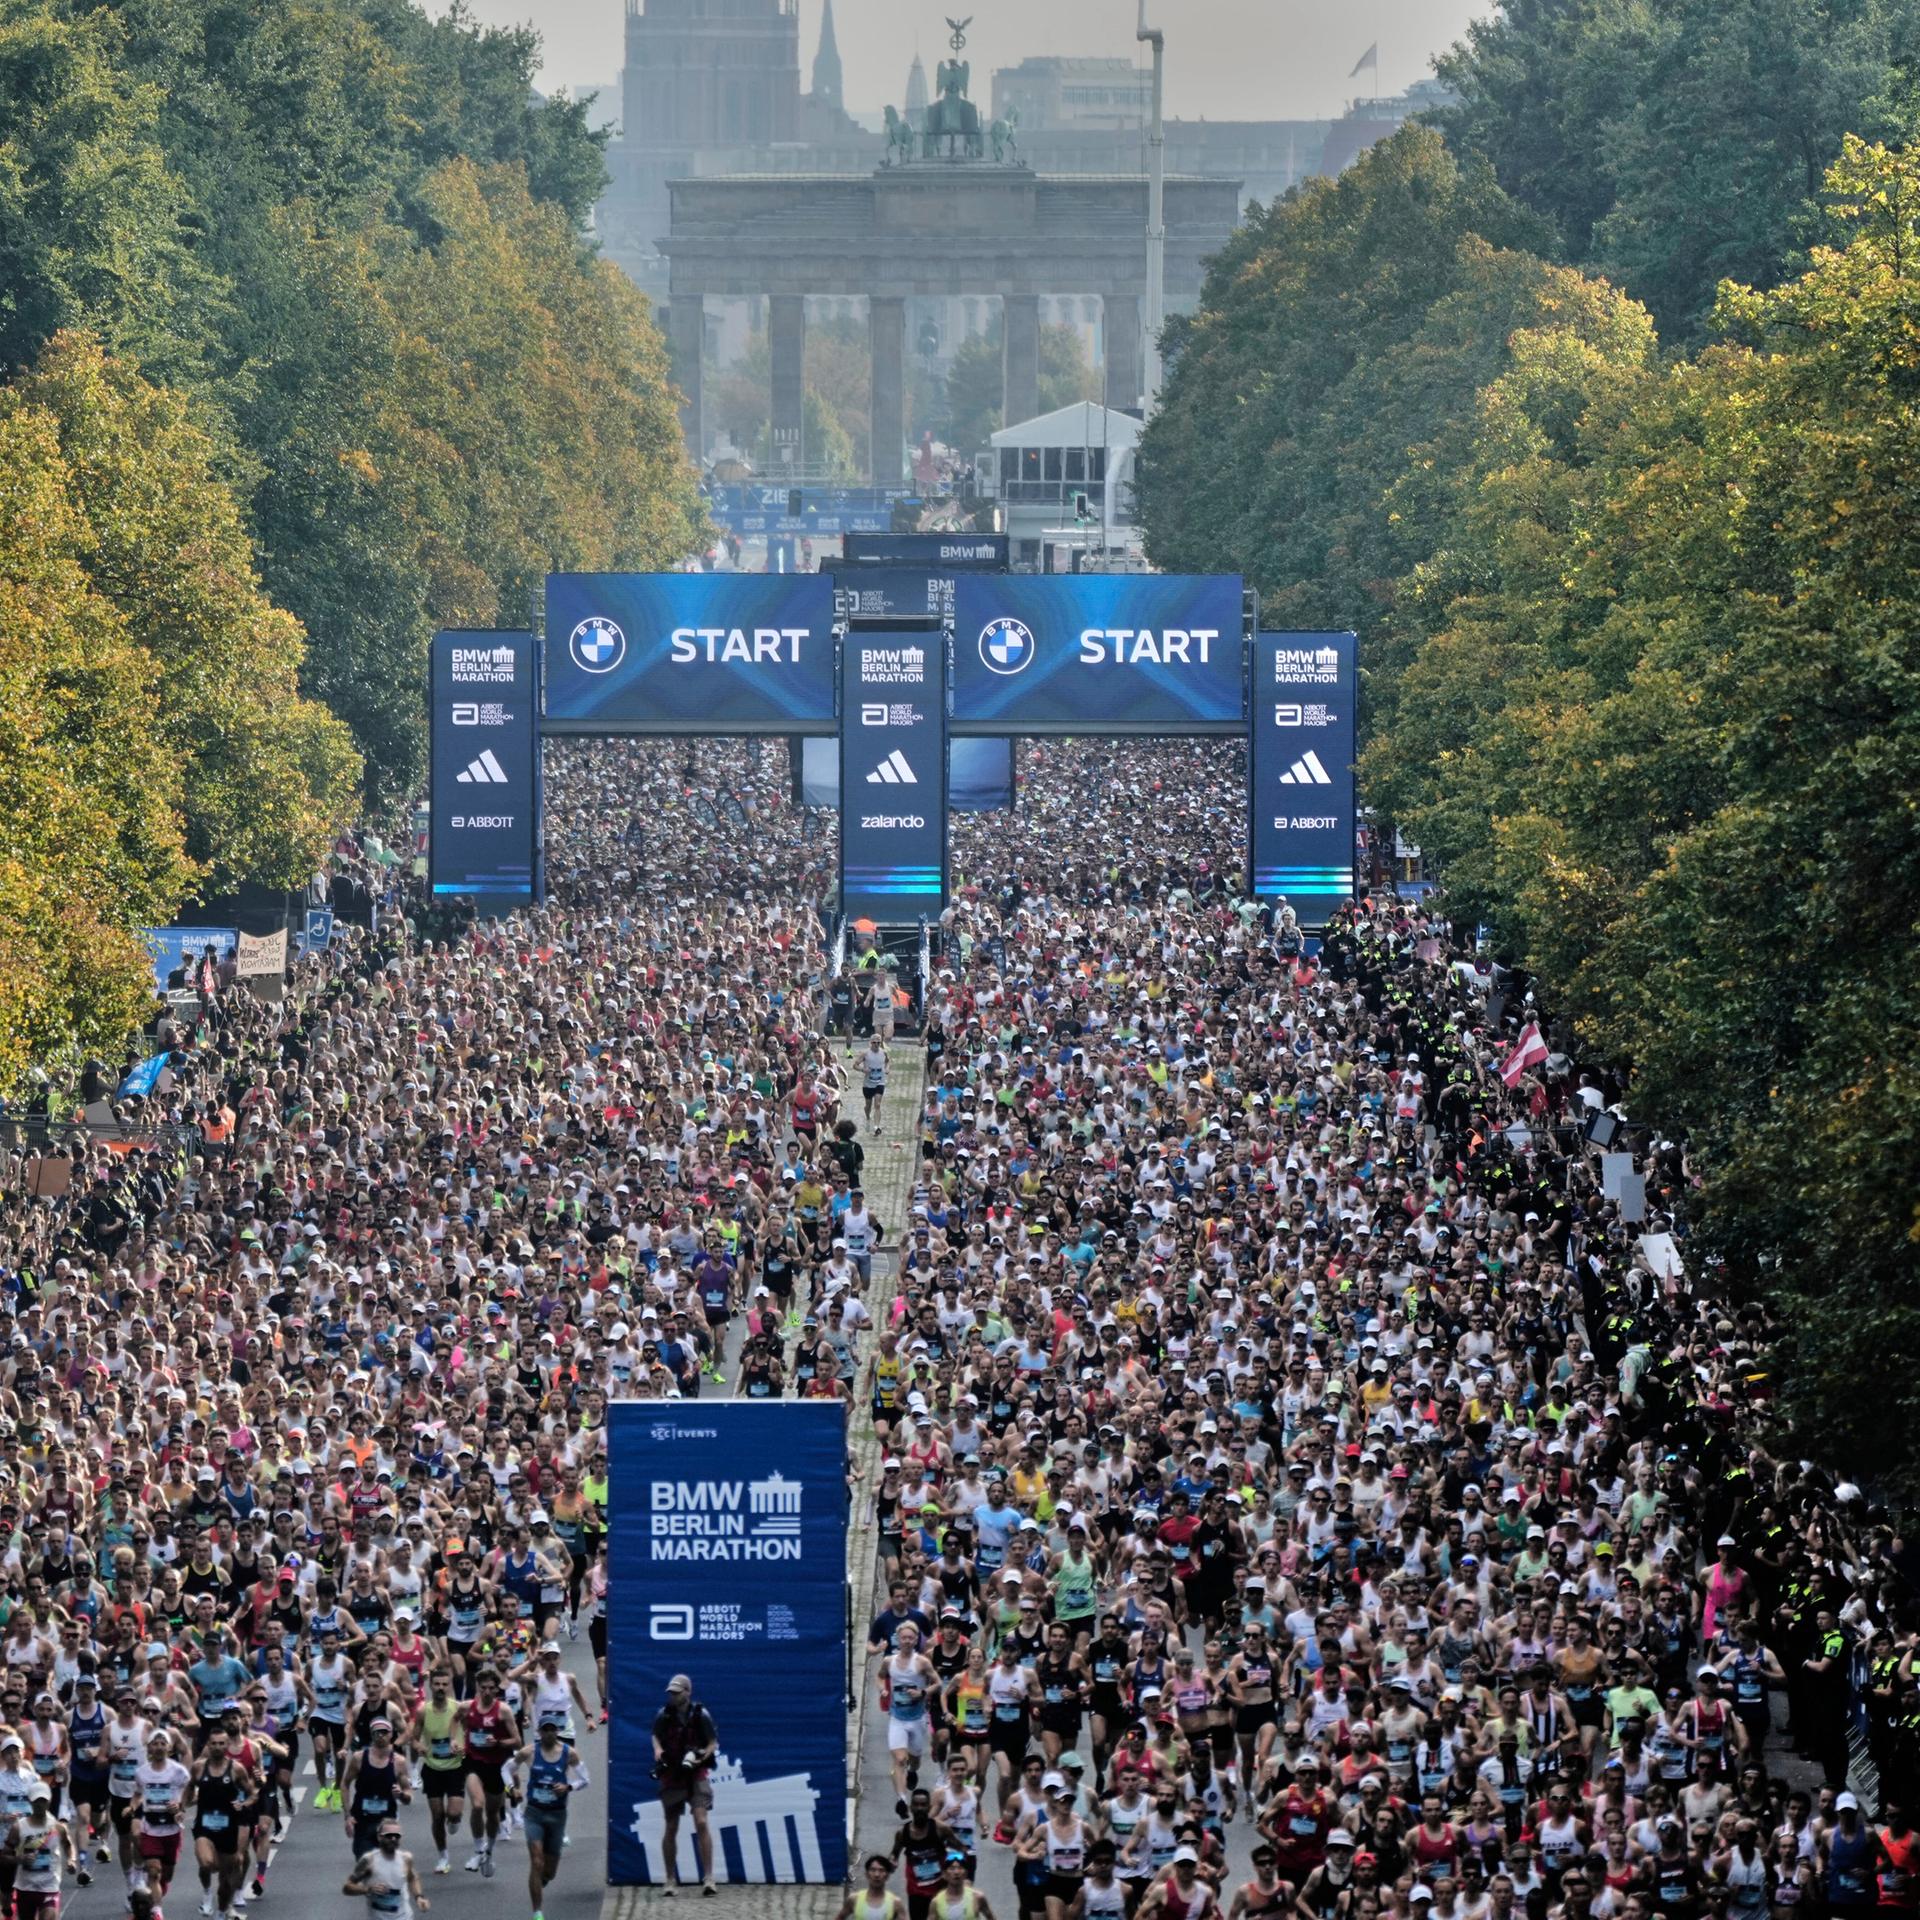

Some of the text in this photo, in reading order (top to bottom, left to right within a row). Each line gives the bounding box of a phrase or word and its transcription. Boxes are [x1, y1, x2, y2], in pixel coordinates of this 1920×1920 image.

[940, 546, 974, 558] BMW
[671, 628, 809, 663] START
[1080, 629, 1218, 664] START
[452, 649, 491, 662] BMW
[862, 650, 900, 663] BMW
[1275, 650, 1314, 663] BMW
[452, 663, 491, 672] BERLIN
[862, 663, 900, 672] BERLIN
[1275, 664, 1315, 673] BERLIN
[452, 673, 514, 682] MARATHON
[862, 673, 924, 682] MARATHON
[1275, 674, 1337, 683] MARATHON
[467, 816, 514, 828] ABBOTT
[861, 814, 924, 828] zalando
[1290, 817, 1338, 829] ABBOTT
[182, 935, 209, 946] BMW
[677, 1429, 717, 1438] EVENTS
[651, 1481, 743, 1511] BMW
[651, 1514, 744, 1535] BERLIN
[651, 1539, 801, 1560] MARATHON
[700, 1605, 741, 1613] ABBOTT
[699, 1614, 738, 1622] WORLD
[700, 1622, 763, 1631] MARATHON
[700, 1631, 744, 1640] MAJORS
